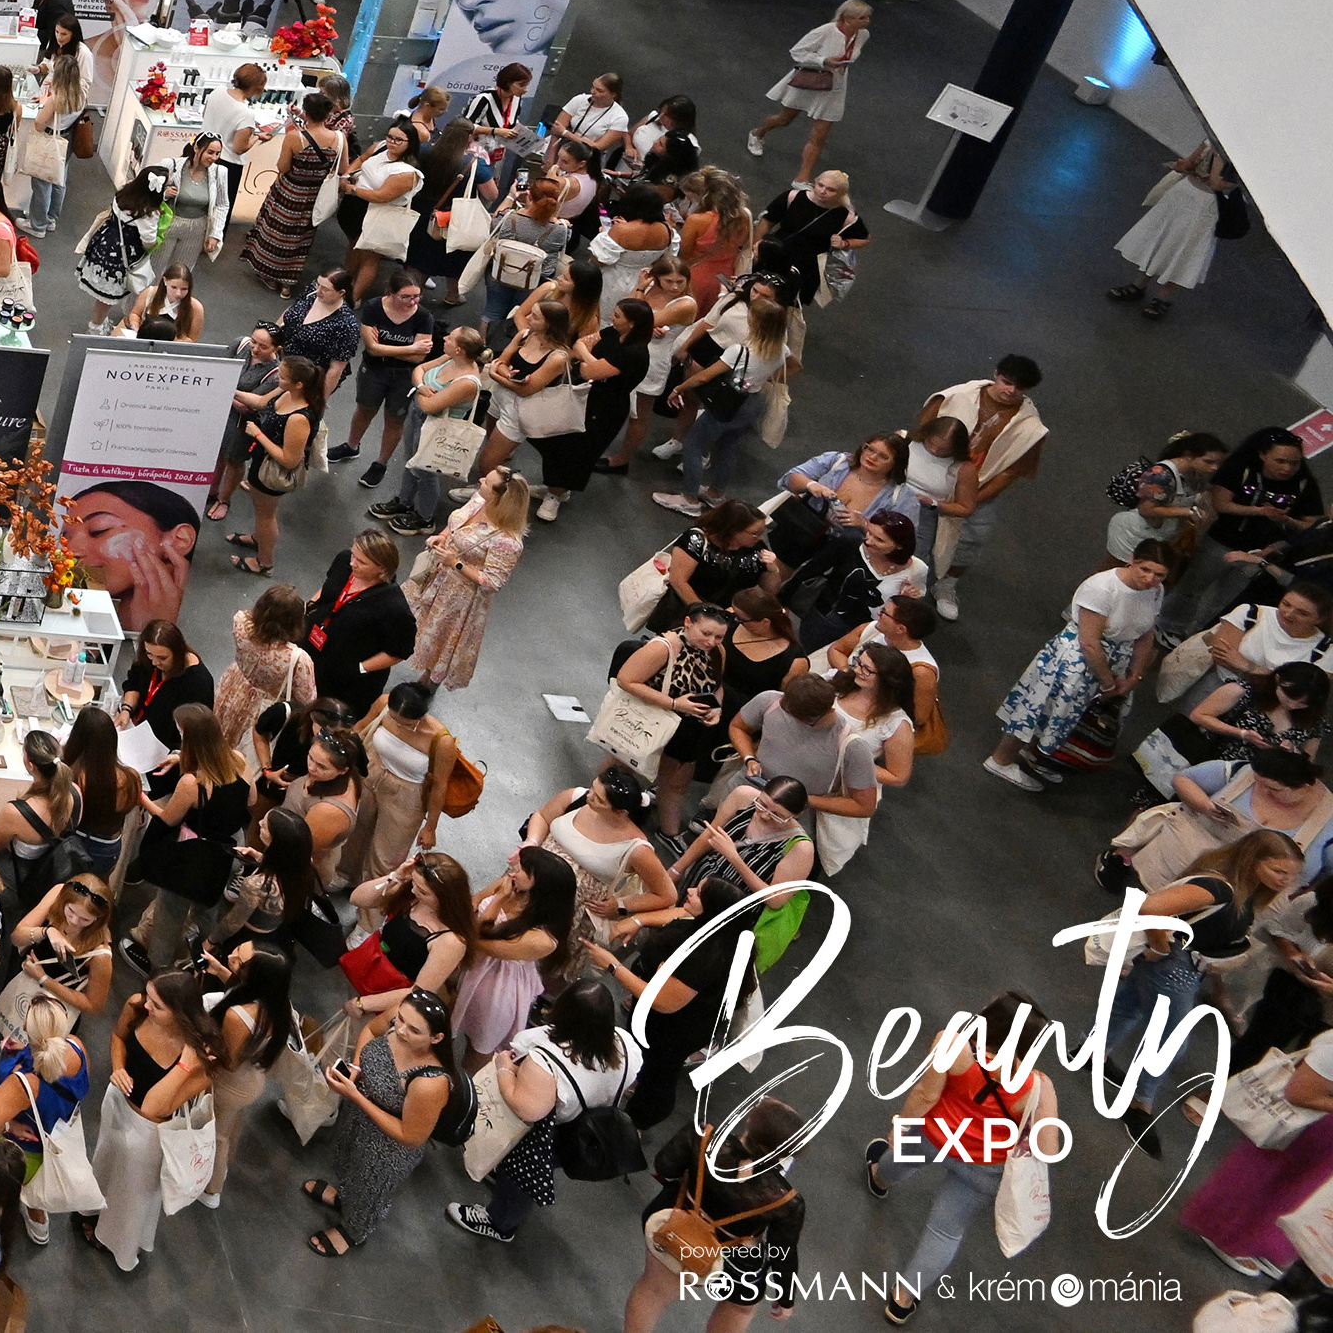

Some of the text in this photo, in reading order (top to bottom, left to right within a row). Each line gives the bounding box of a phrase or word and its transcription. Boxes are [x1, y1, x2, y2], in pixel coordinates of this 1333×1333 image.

[157, 133, 197, 141] ROSSMAN
[128, 364, 196, 373] LABORATOIRES
[106, 370, 215, 388] NOVEXPERT
[68, 464, 209, 483] Tiszta és hatékony bőrápolás 2008 óta
